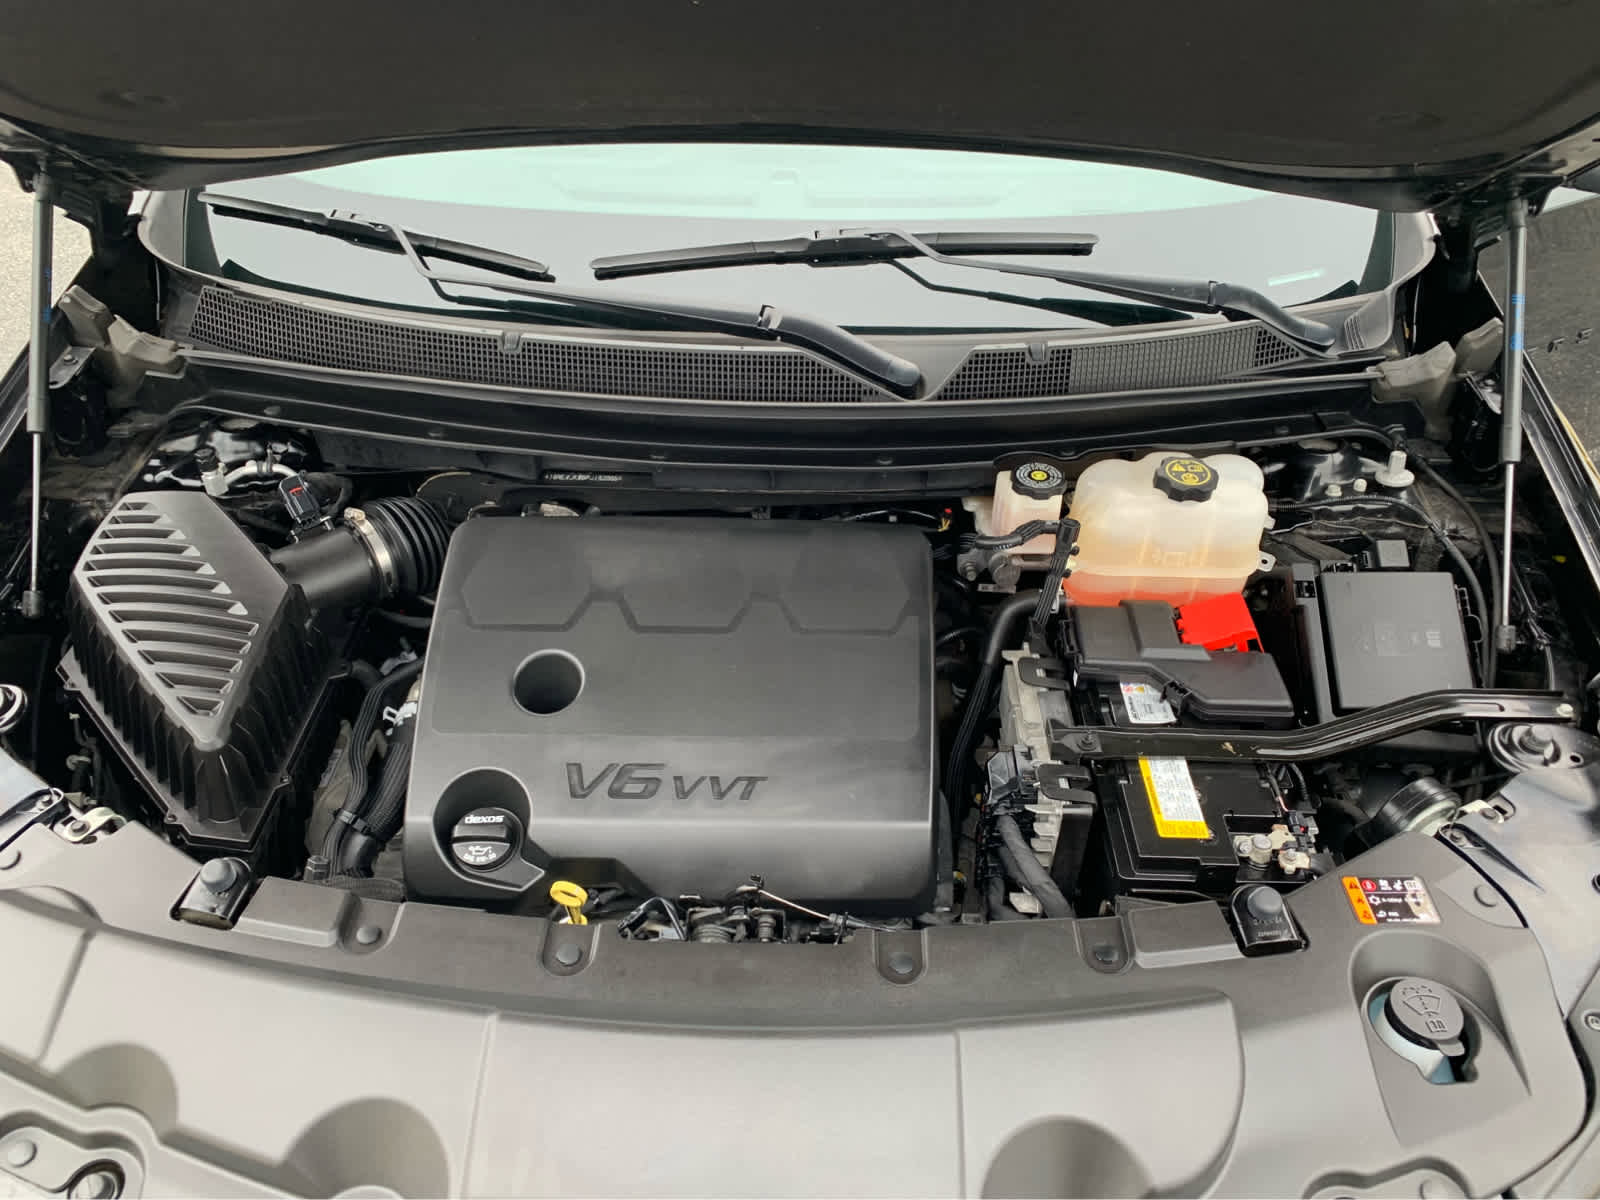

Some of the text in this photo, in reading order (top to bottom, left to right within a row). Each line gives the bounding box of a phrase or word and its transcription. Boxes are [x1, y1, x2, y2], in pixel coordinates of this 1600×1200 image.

[566, 762, 768, 800] V6 VVT
[464, 814, 505, 824] dexos
